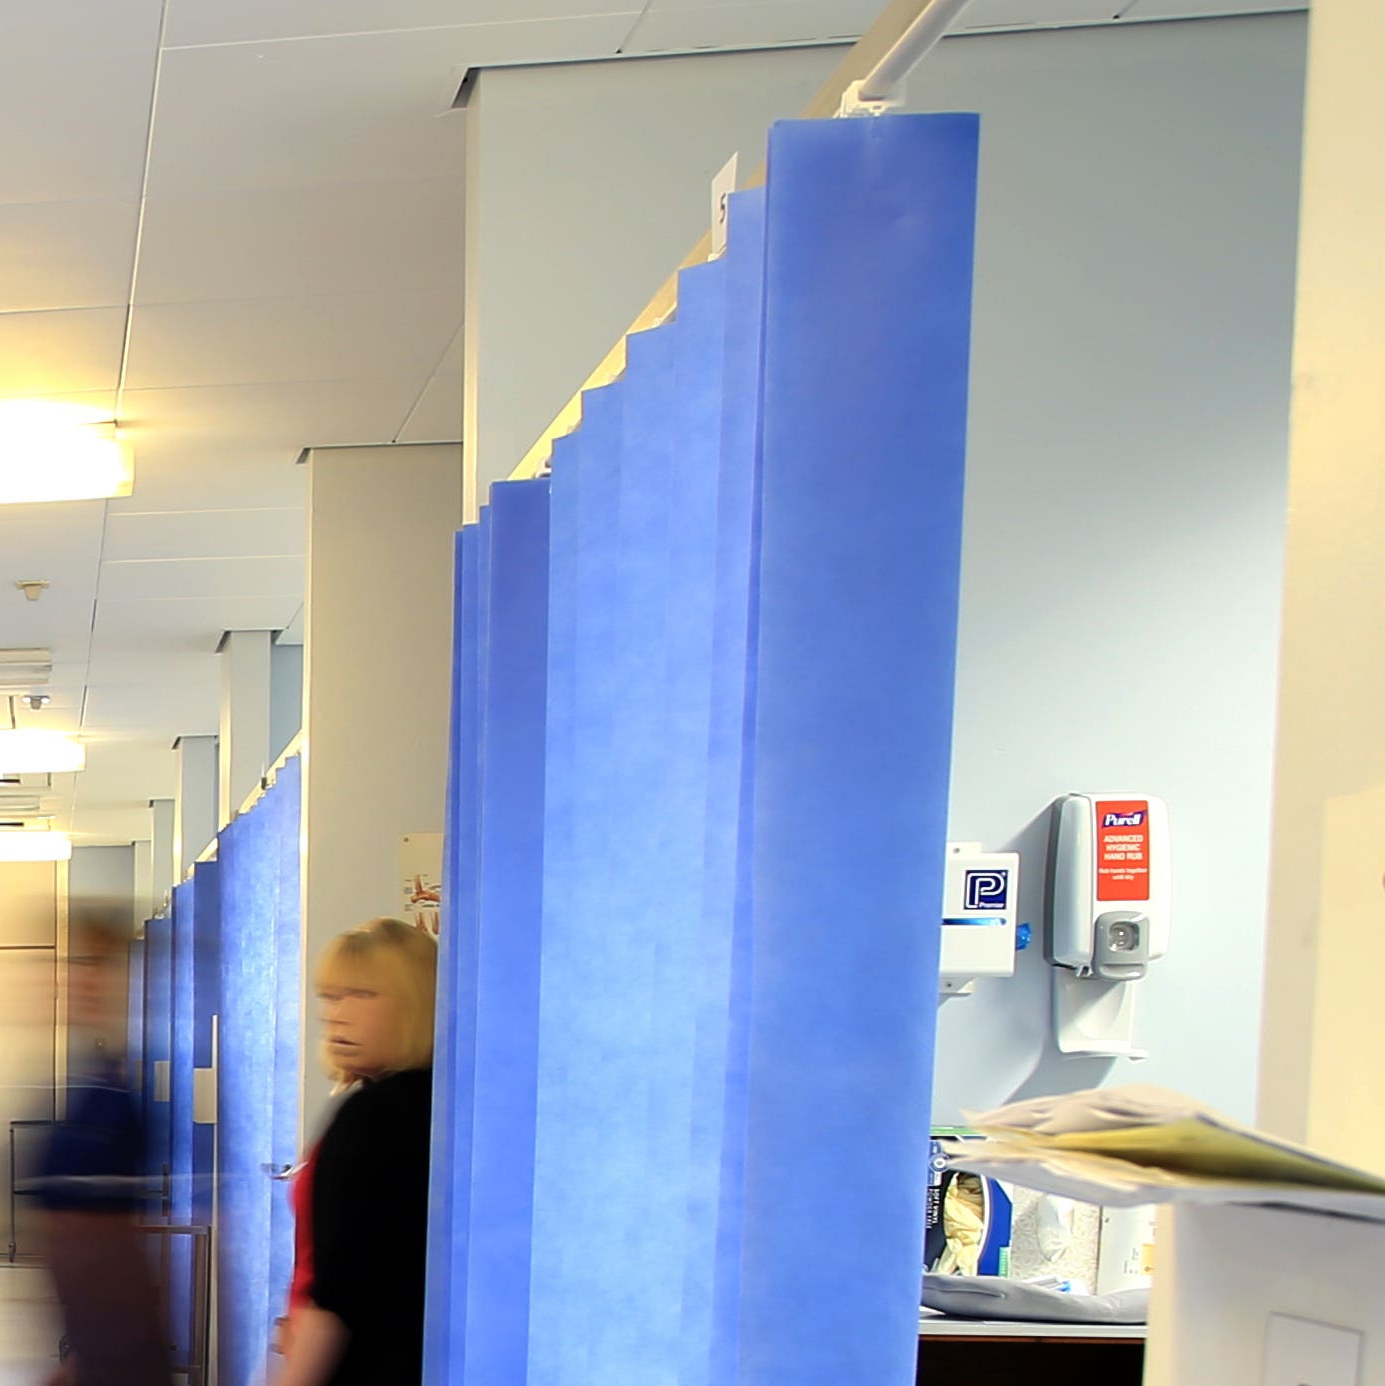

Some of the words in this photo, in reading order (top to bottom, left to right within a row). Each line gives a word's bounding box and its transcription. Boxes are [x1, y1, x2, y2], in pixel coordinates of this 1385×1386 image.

[1105, 813, 1142, 826] Purell
[1103, 834, 1144, 843] ADVANCED
[1105, 843, 1141, 852] HYGIENIC
[1103, 852, 1125, 861] HAND
[1126, 852, 1143, 860] RUB
